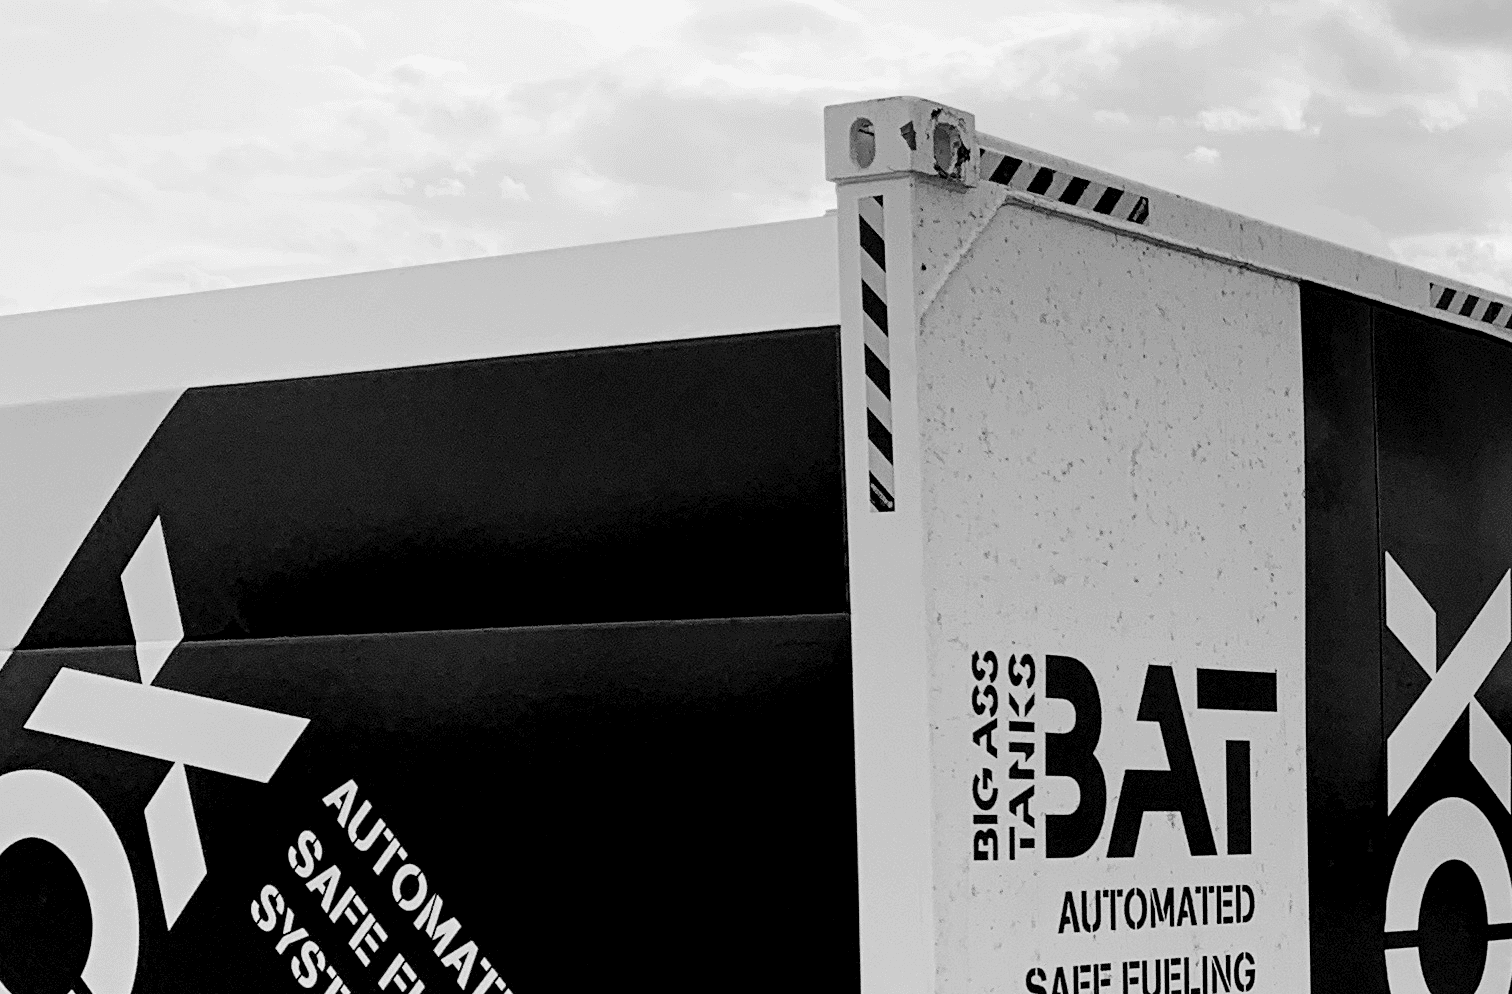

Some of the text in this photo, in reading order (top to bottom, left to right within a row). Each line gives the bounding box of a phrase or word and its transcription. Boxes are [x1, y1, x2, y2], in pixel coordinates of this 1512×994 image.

[971, 650, 999, 861] BIG ASS
[1008, 653, 1036, 861] TANKS
[1045, 654, 1278, 859] BAT
[288, 829, 389, 968] SAFE
[1058, 884, 1256, 934] AUTOMATED
